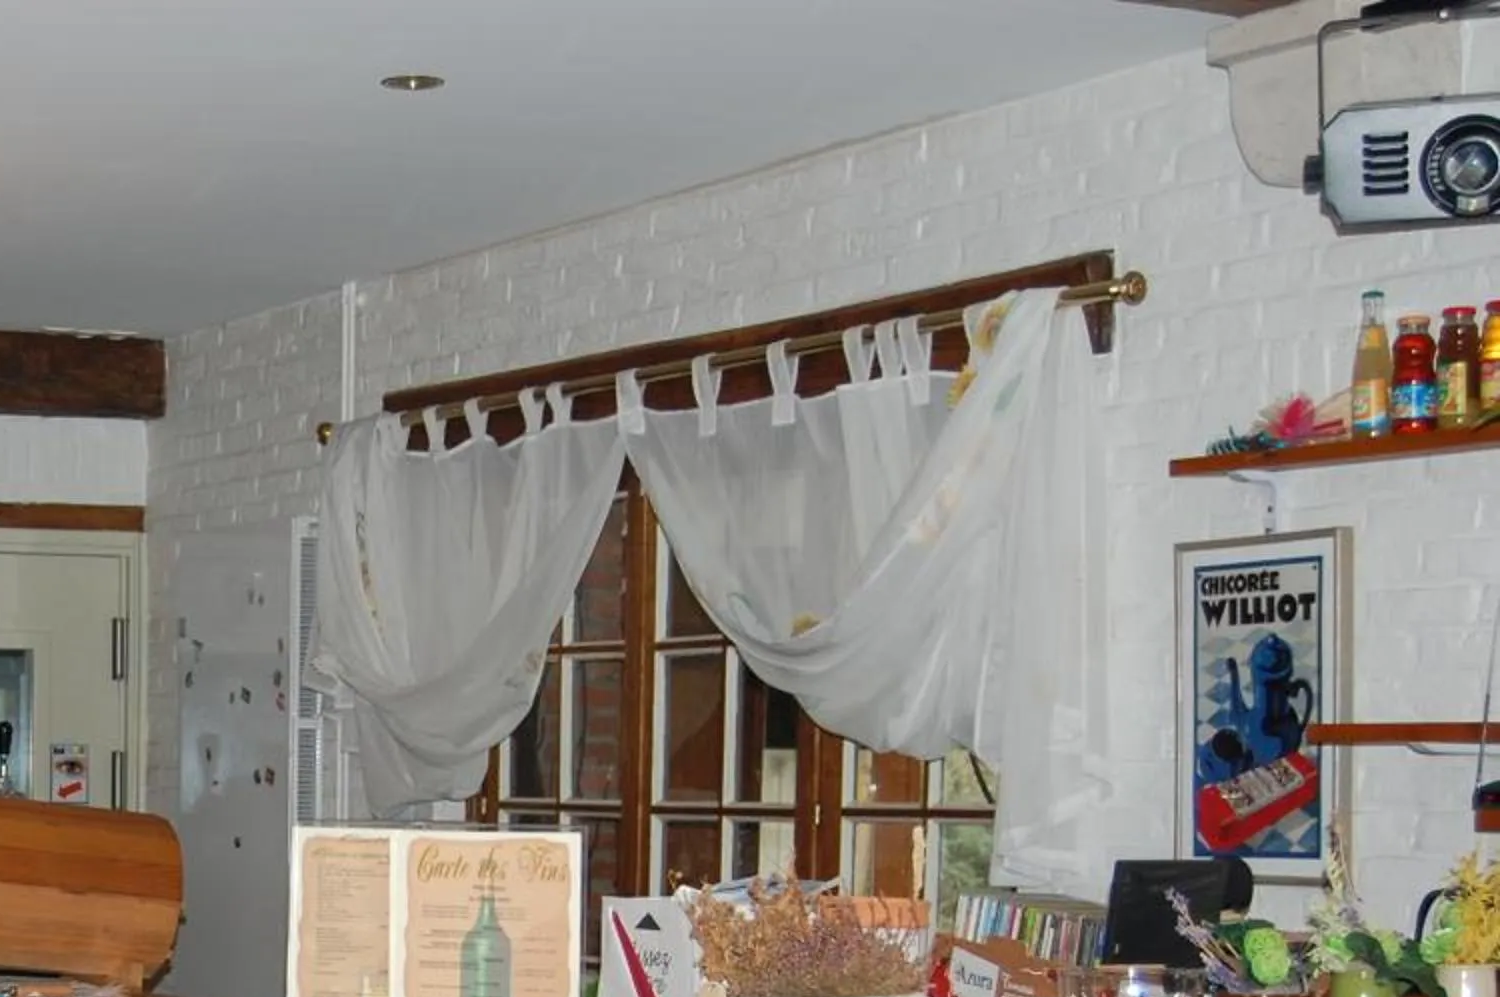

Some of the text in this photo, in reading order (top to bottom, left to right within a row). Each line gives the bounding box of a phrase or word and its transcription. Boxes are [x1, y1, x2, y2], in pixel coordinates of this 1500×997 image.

[1201, 568, 1279, 596] CHICORÉE
[1201, 592, 1316, 628] WILLIOT
[416, 843, 469, 882] Carte
